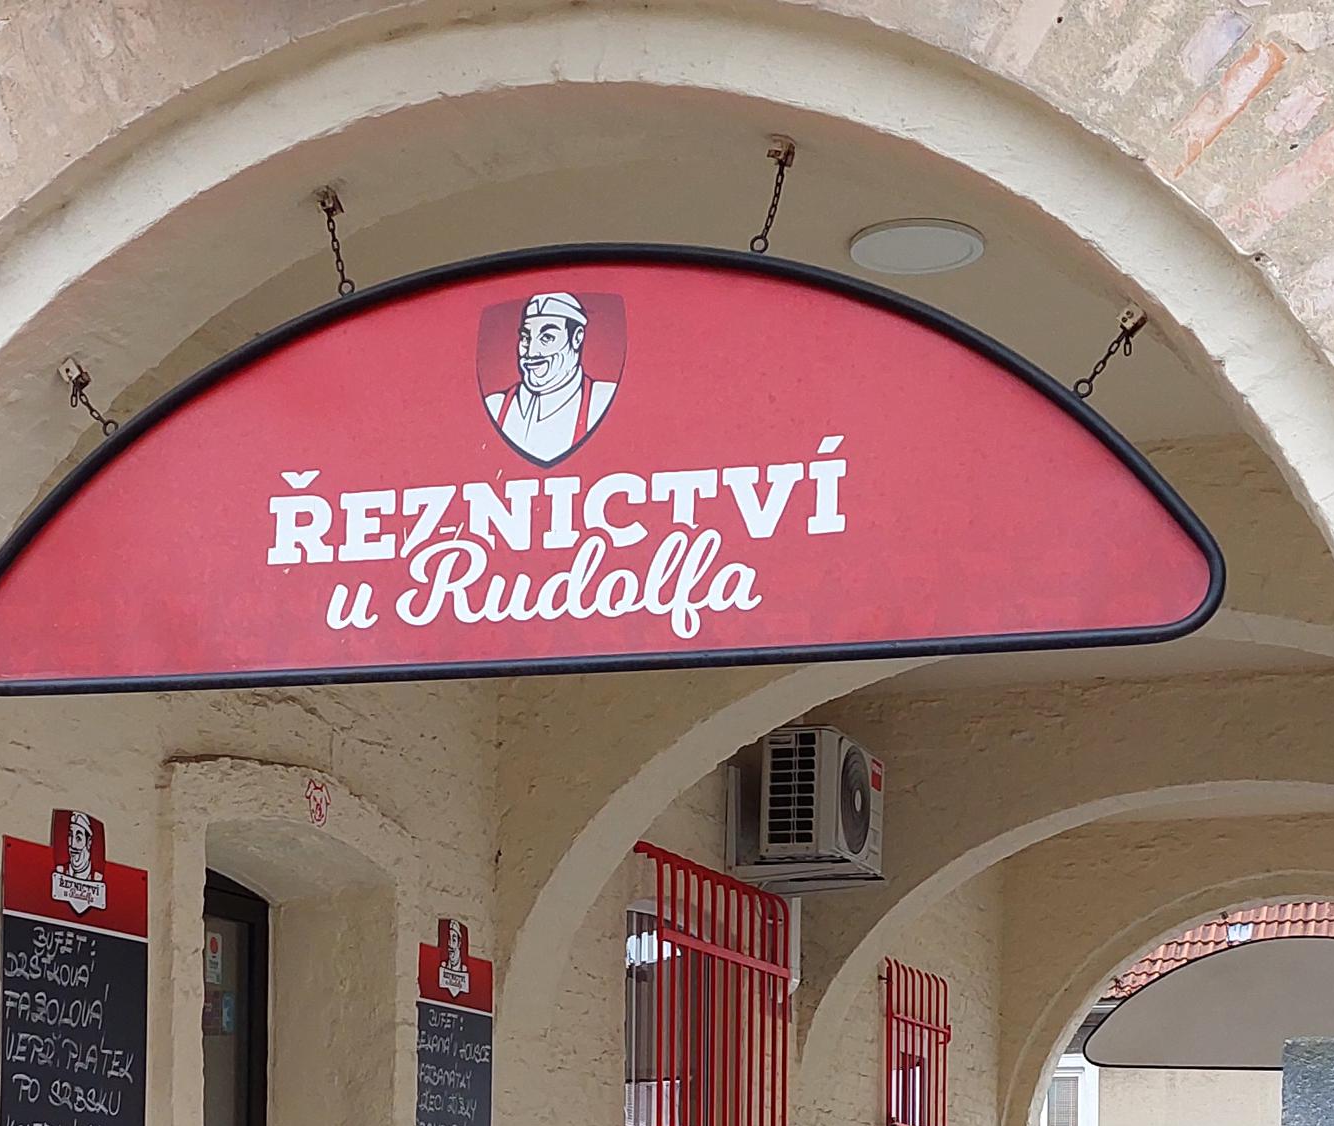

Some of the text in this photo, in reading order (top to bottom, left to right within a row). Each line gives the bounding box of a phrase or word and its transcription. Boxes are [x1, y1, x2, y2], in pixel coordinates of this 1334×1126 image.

[267, 435, 847, 566] ŘEZNICTVÍ
[325, 529, 763, 640] u Rudolfa
[12, 1073, 41, 1103] PO
